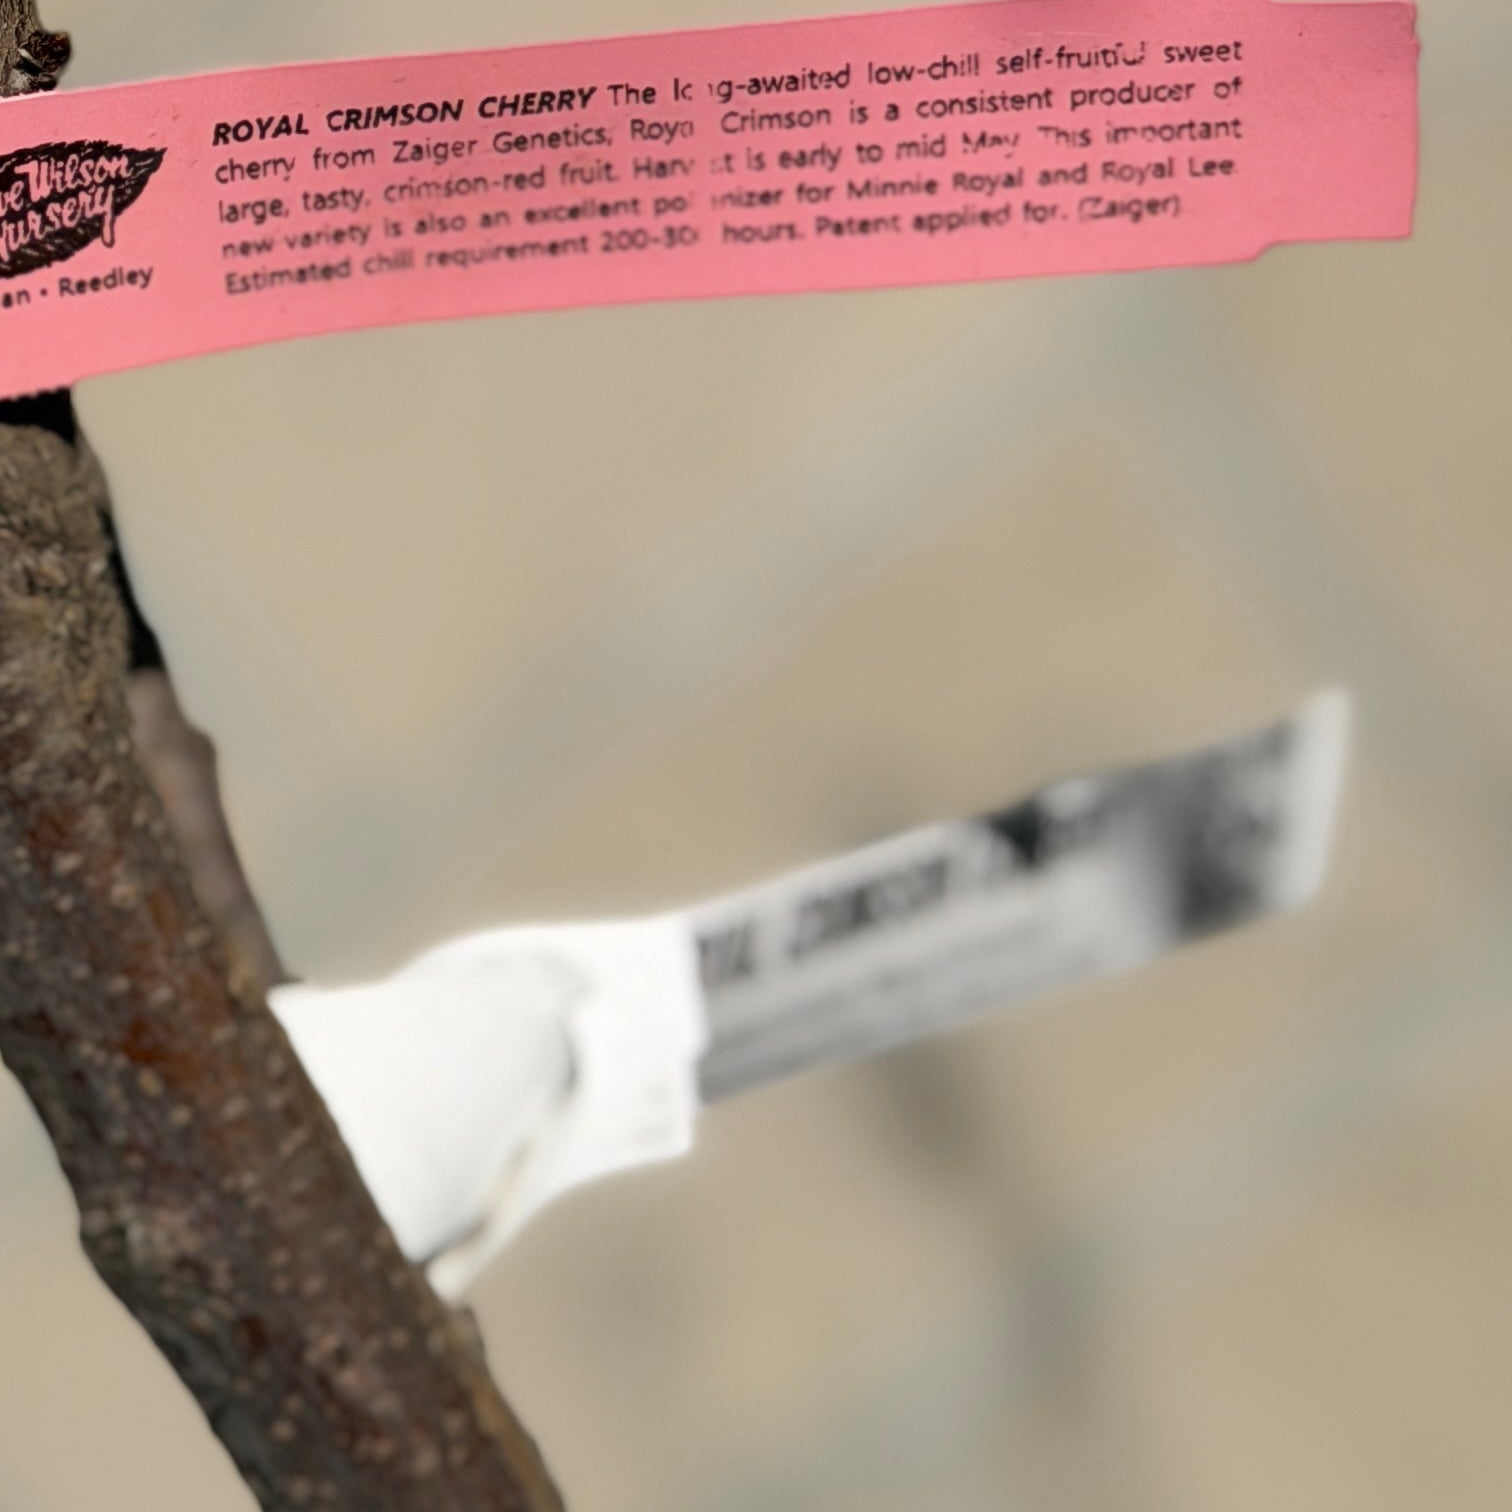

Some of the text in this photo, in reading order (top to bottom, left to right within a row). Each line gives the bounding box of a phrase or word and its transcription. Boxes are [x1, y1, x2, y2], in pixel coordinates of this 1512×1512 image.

[212, 112, 309, 146] ROYAL
[326, 99, 463, 133] CRIMSON
[478, 86, 597, 119] CHERRY
[607, 82, 657, 106] The
[868, 52, 980, 85] low-chill
[1163, 40, 1243, 65] sweet
[215, 75, 1243, 185] cherry from Zaiger Genetics, Roya Crimson is a consistent producer of
[15, 154, 133, 203] Wilson
[219, 198, 290, 226] large,
[384, 164, 546, 203] crimson-red
[746, 147, 766, 171] is
[778, 143, 843, 173] early
[856, 142, 884, 164] to
[895, 134, 948, 161] mid
[1037, 124, 1092, 149] This
[222, 238, 275, 260] new
[284, 222, 371, 248] variety
[384, 216, 403, 238] is
[414, 212, 467, 235] also
[479, 210, 510, 229] an
[524, 196, 640, 225] excellent
[796, 181, 835, 205] for
[846, 172, 939, 199] Minnie
[952, 166, 1024, 197] Royal
[1038, 162, 1089, 188] and
[1101, 156, 1175, 186] Royal
[58, 267, 154, 299] Reedley
[226, 258, 352, 296] Estimated
[362, 248, 415, 276] chill
[425, 236, 589, 268] requirement
[814, 215, 901, 239] Patent
[911, 200, 1011, 234] applied
[1022, 199, 1068, 224] for.
